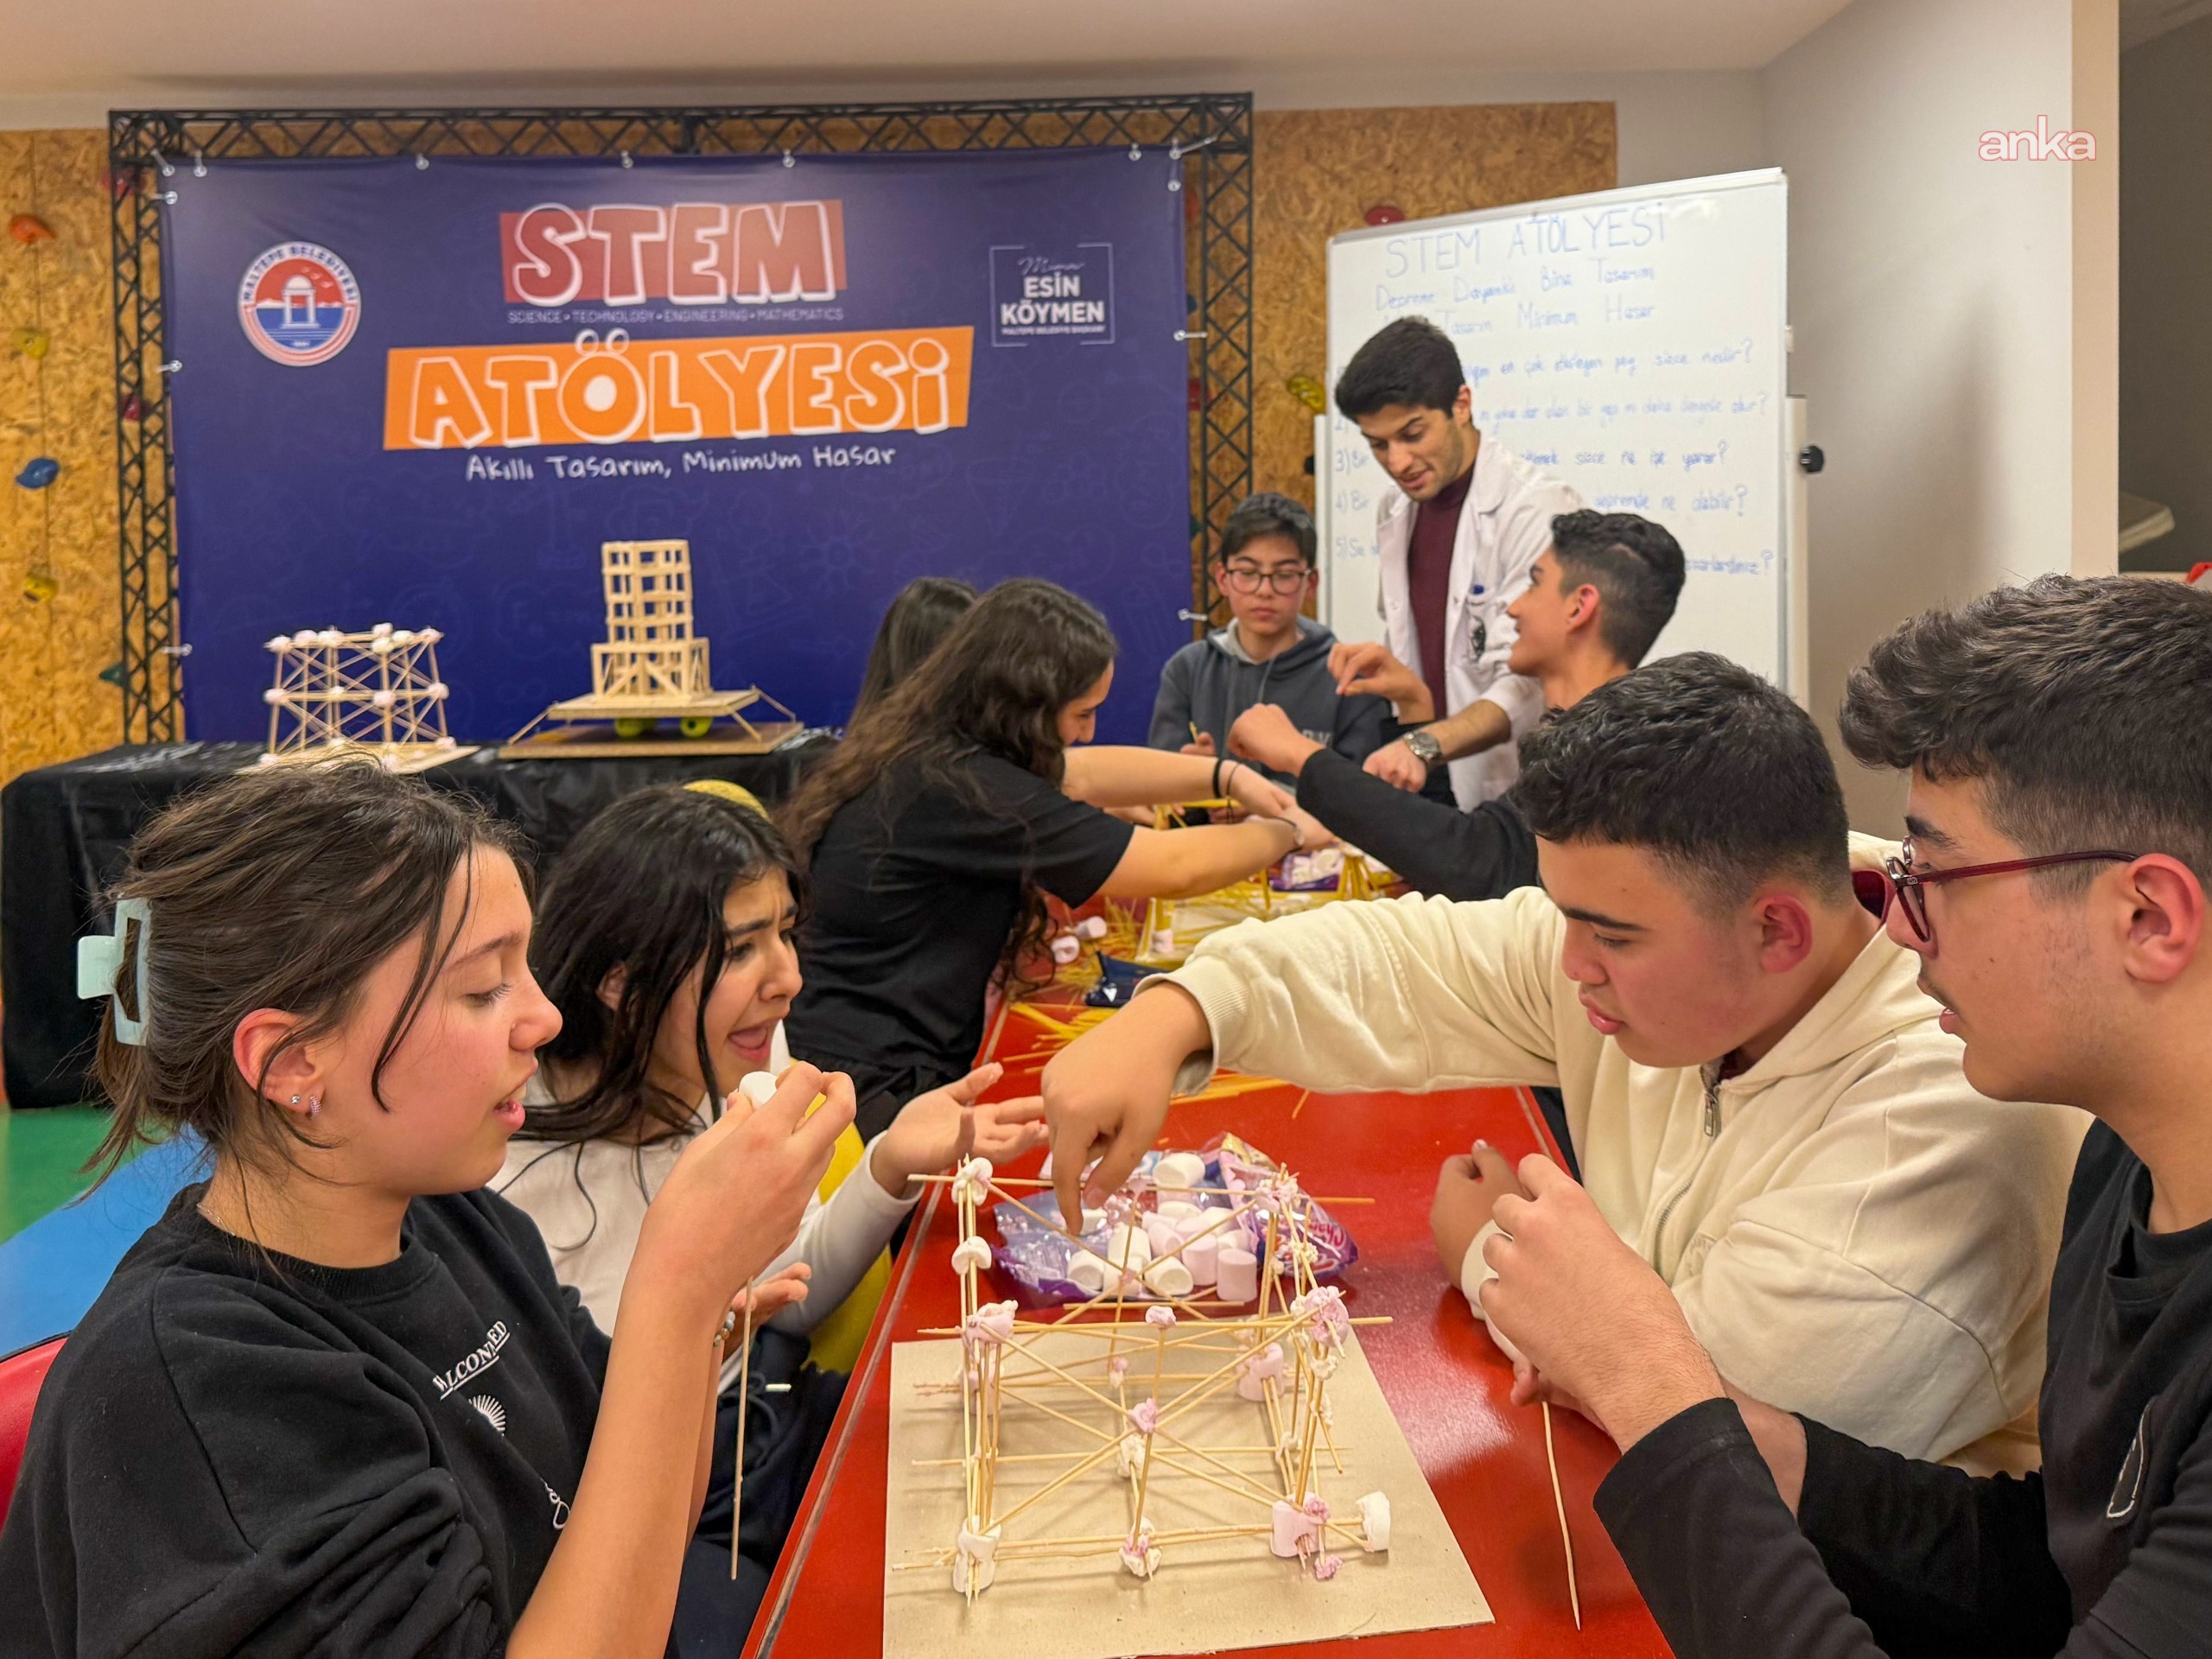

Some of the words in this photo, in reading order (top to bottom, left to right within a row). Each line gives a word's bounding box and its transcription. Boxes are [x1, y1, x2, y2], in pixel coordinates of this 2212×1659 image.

[513, 201, 836, 307] STEM
[1385, 228, 1481, 277] STEM
[1508, 202, 1665, 259] ATÖLYESİ
[1024, 271, 1080, 298] ESİN
[757, 307, 845, 322] MATHEMATICS
[1001, 299, 1105, 326] KÖYMEN
[409, 328, 950, 448] ATÖLYESİ
[467, 454, 532, 482] Akıllı
[683, 446, 802, 474] Minimum
[813, 443, 896, 468] Hasar
